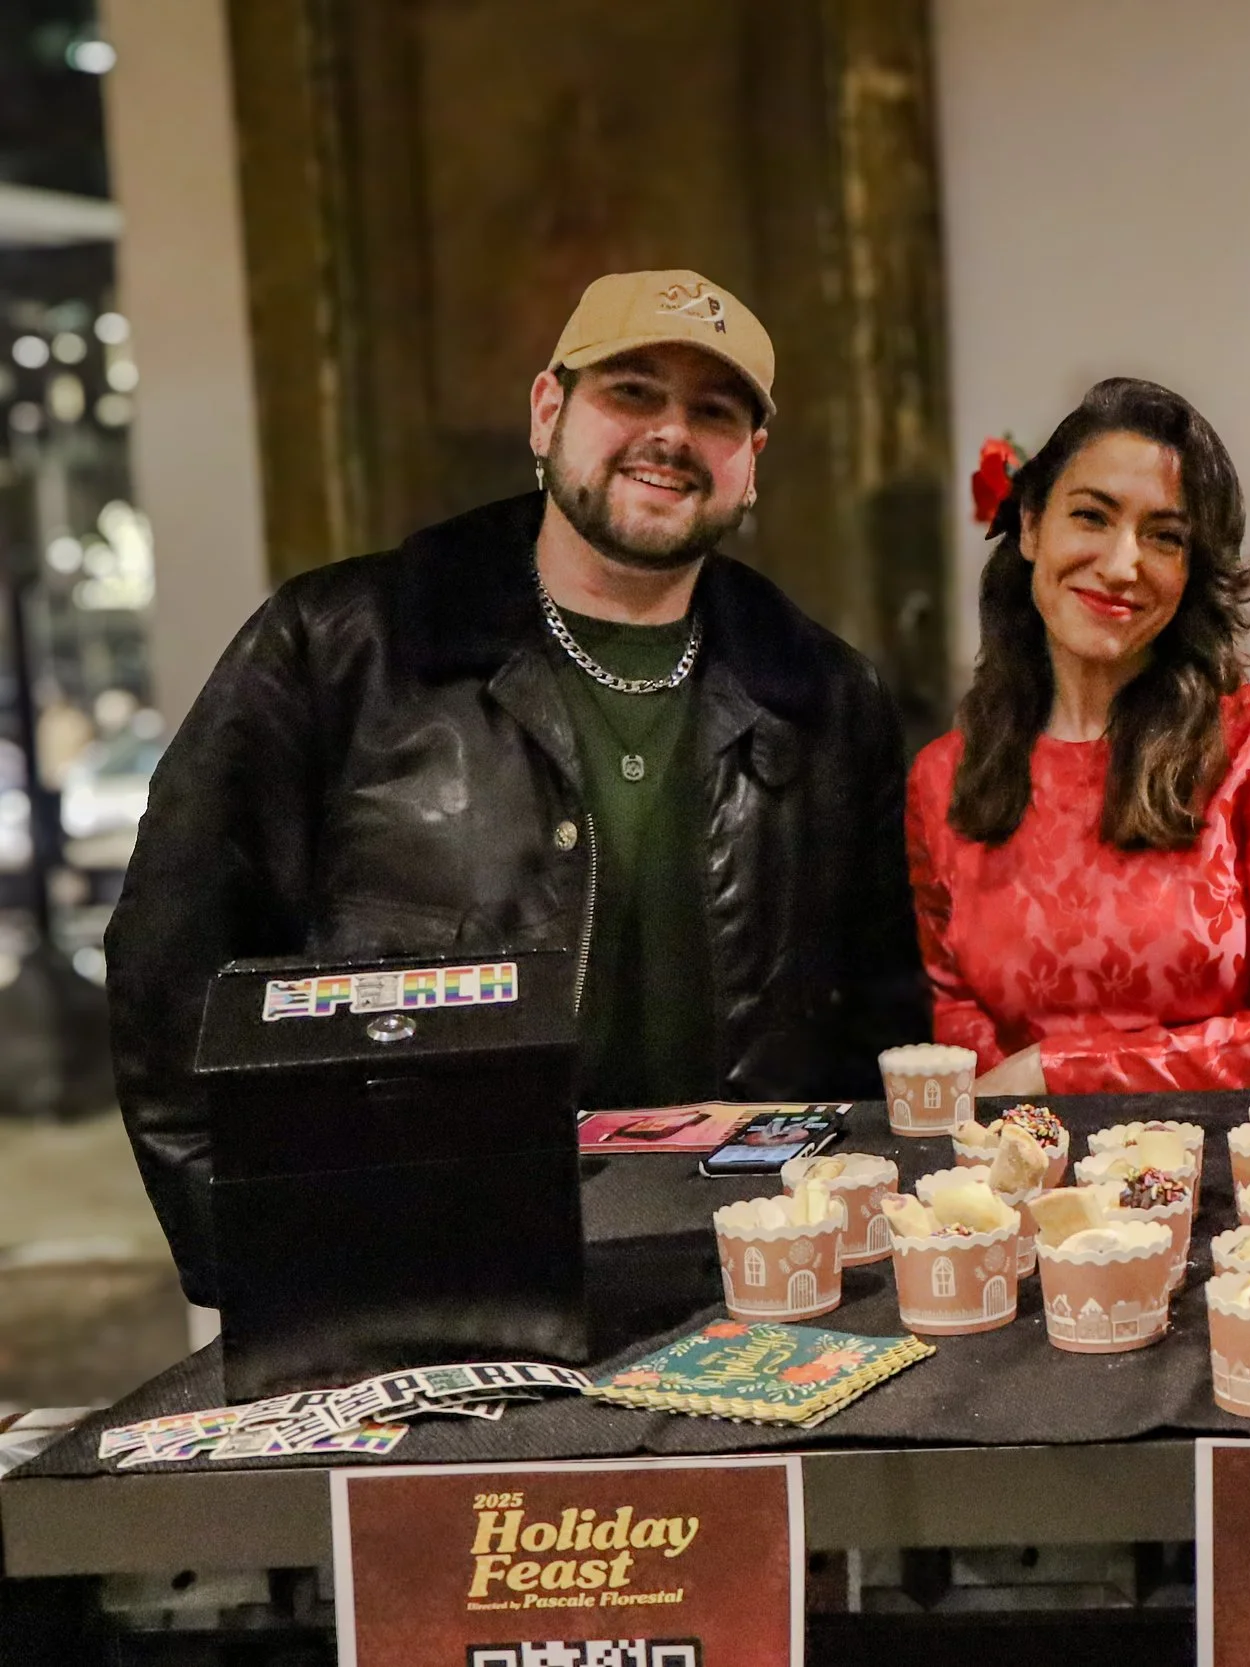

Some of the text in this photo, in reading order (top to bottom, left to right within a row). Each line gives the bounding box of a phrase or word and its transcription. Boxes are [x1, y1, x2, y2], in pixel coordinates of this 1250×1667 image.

[473, 1493, 524, 1510] 2025
[470, 1506, 699, 1557] Holiday
[468, 1551, 634, 1598] Feast
[467, 1588, 684, 1611] Directed by Pascale Florestal
